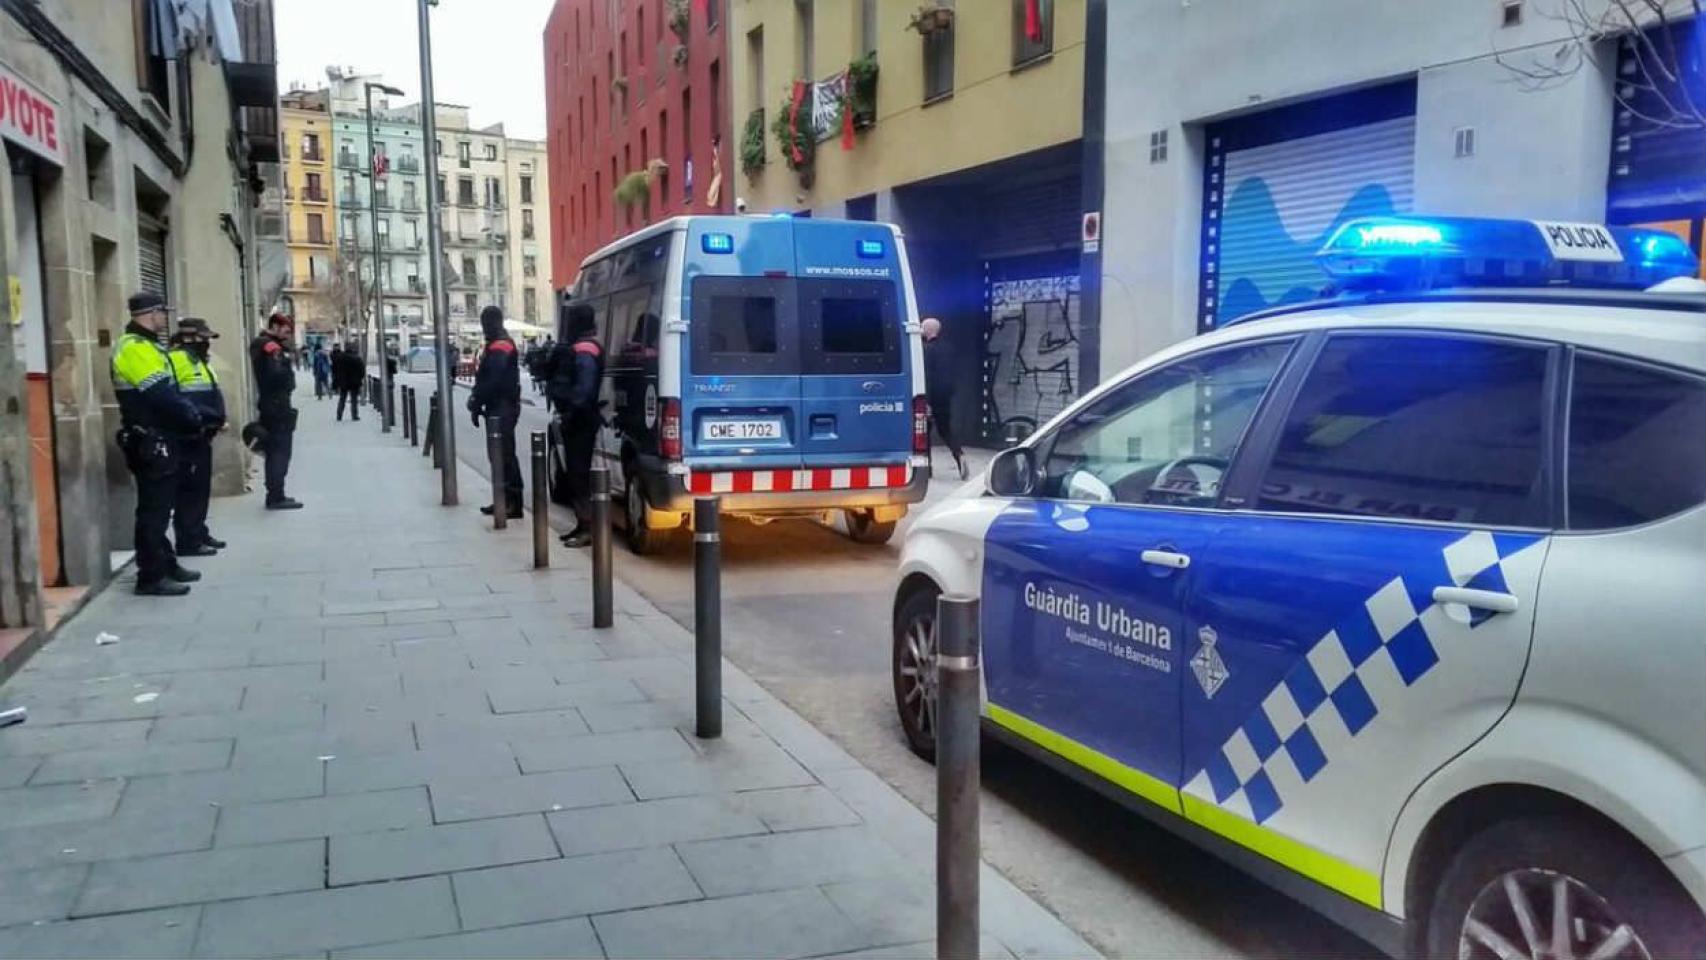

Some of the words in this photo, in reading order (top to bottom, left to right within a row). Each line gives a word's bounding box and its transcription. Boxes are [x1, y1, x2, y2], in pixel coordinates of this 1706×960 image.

[0, 76, 57, 150] YOTE
[1546, 224, 1613, 249] POLICIA
[806, 266, 890, 277] www.mossos.cat
[693, 383, 737, 393] TRANSIT
[859, 402, 894, 415] policia
[710, 424, 736, 437] CME
[742, 423, 773, 437] 1702
[1024, 581, 1090, 625] Guàrdia
[1096, 600, 1172, 651] Urbana
[1113, 642, 1125, 658] de
[1125, 645, 1172, 674] Barcelona
